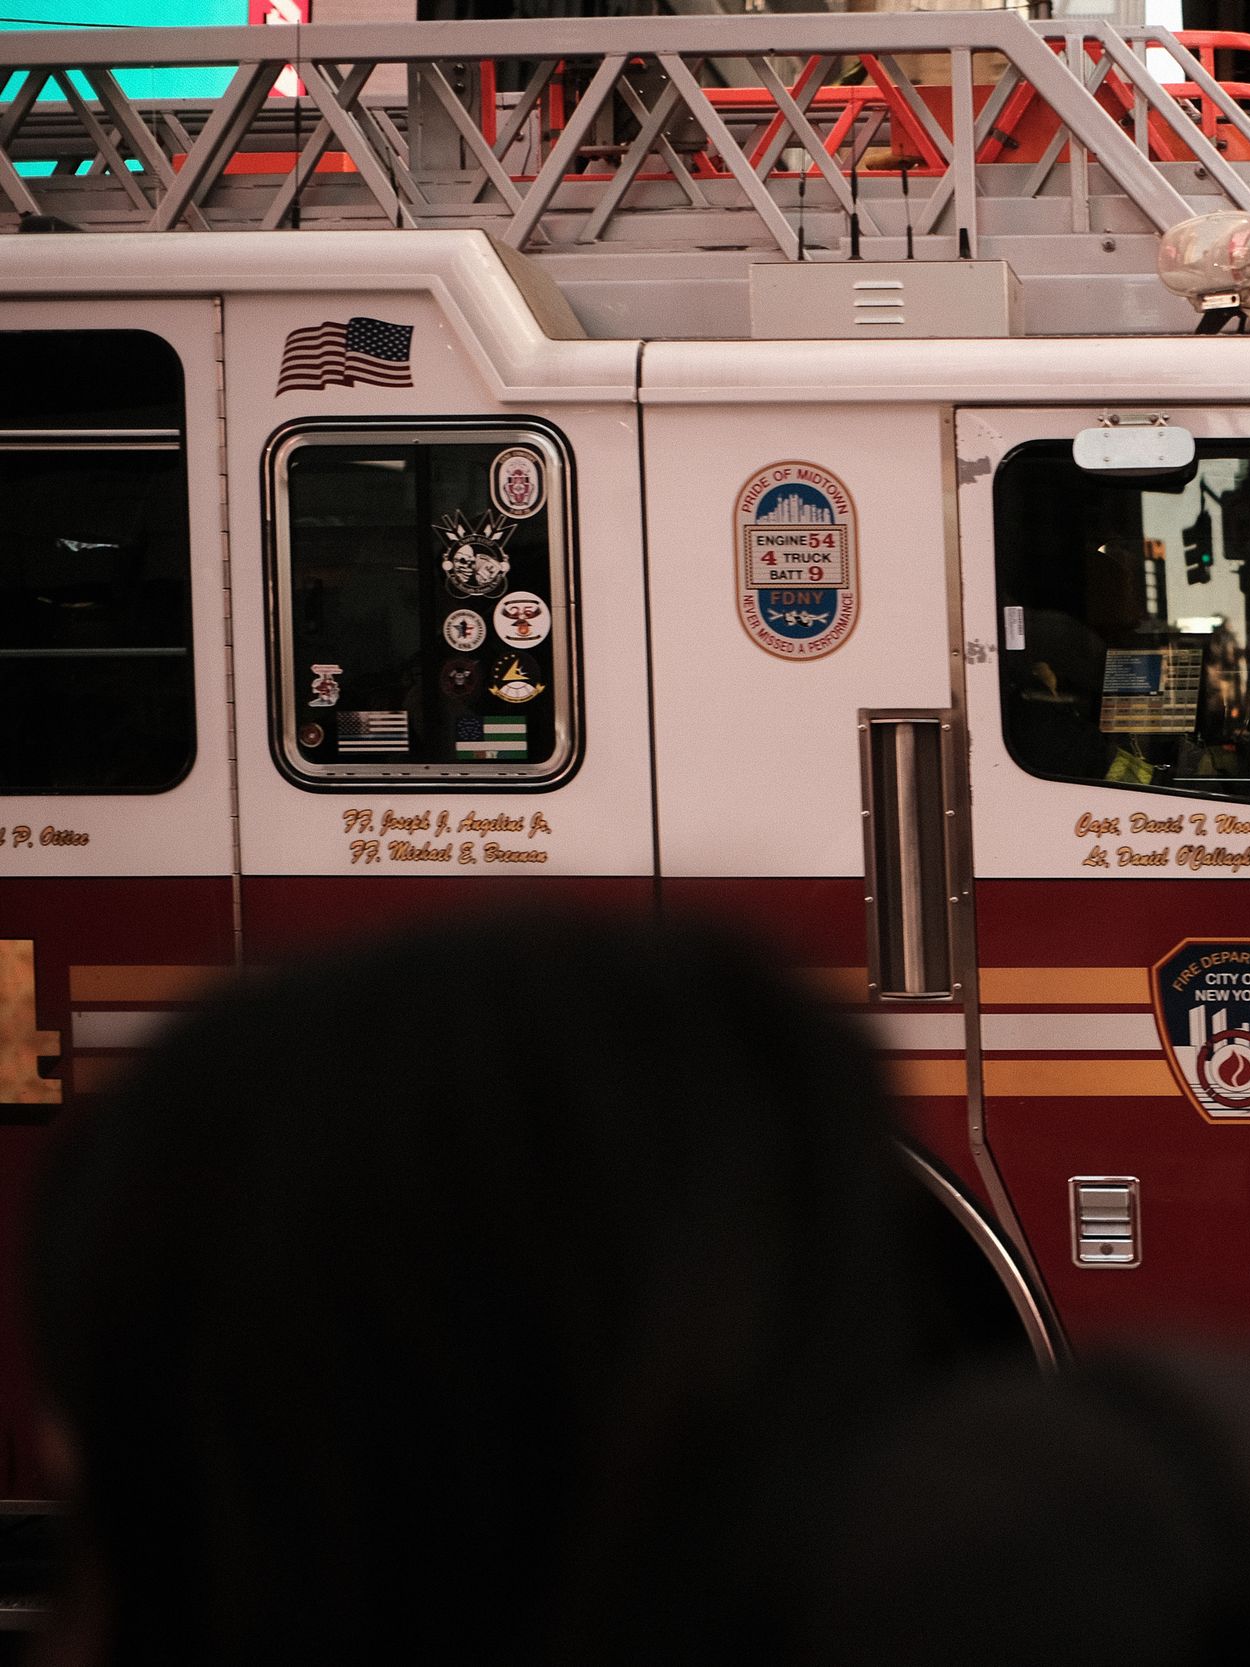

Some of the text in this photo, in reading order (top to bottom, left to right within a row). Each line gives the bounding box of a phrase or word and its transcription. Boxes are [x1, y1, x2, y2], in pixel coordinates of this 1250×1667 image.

[742, 469, 848, 514] PRIDE OF MIDTOWN
[757, 533, 836, 548] ENGINE 54
[761, 550, 832, 566] 4 TRUCK
[770, 566, 824, 581] BATT 9
[771, 591, 824, 605] FDNY
[743, 592, 853, 654] NEVER MISSED A PERFORMANCE
[343, 808, 552, 839] FF. Joseph J. Angelini Jr.
[1074, 812, 1122, 838] Capt.
[1129, 812, 1184, 834] David
[1188, 813, 1208, 836] T.
[12, 825, 34, 848] P.
[350, 839, 548, 865] FF. Michael E. Brennan
[1082, 845, 1110, 868] Lt.
[1116, 846, 1170, 867] Daniel
[1172, 961, 1200, 992] FIRE
[1205, 973, 1240, 985] CITY
[1194, 990, 1232, 1001] NEW
